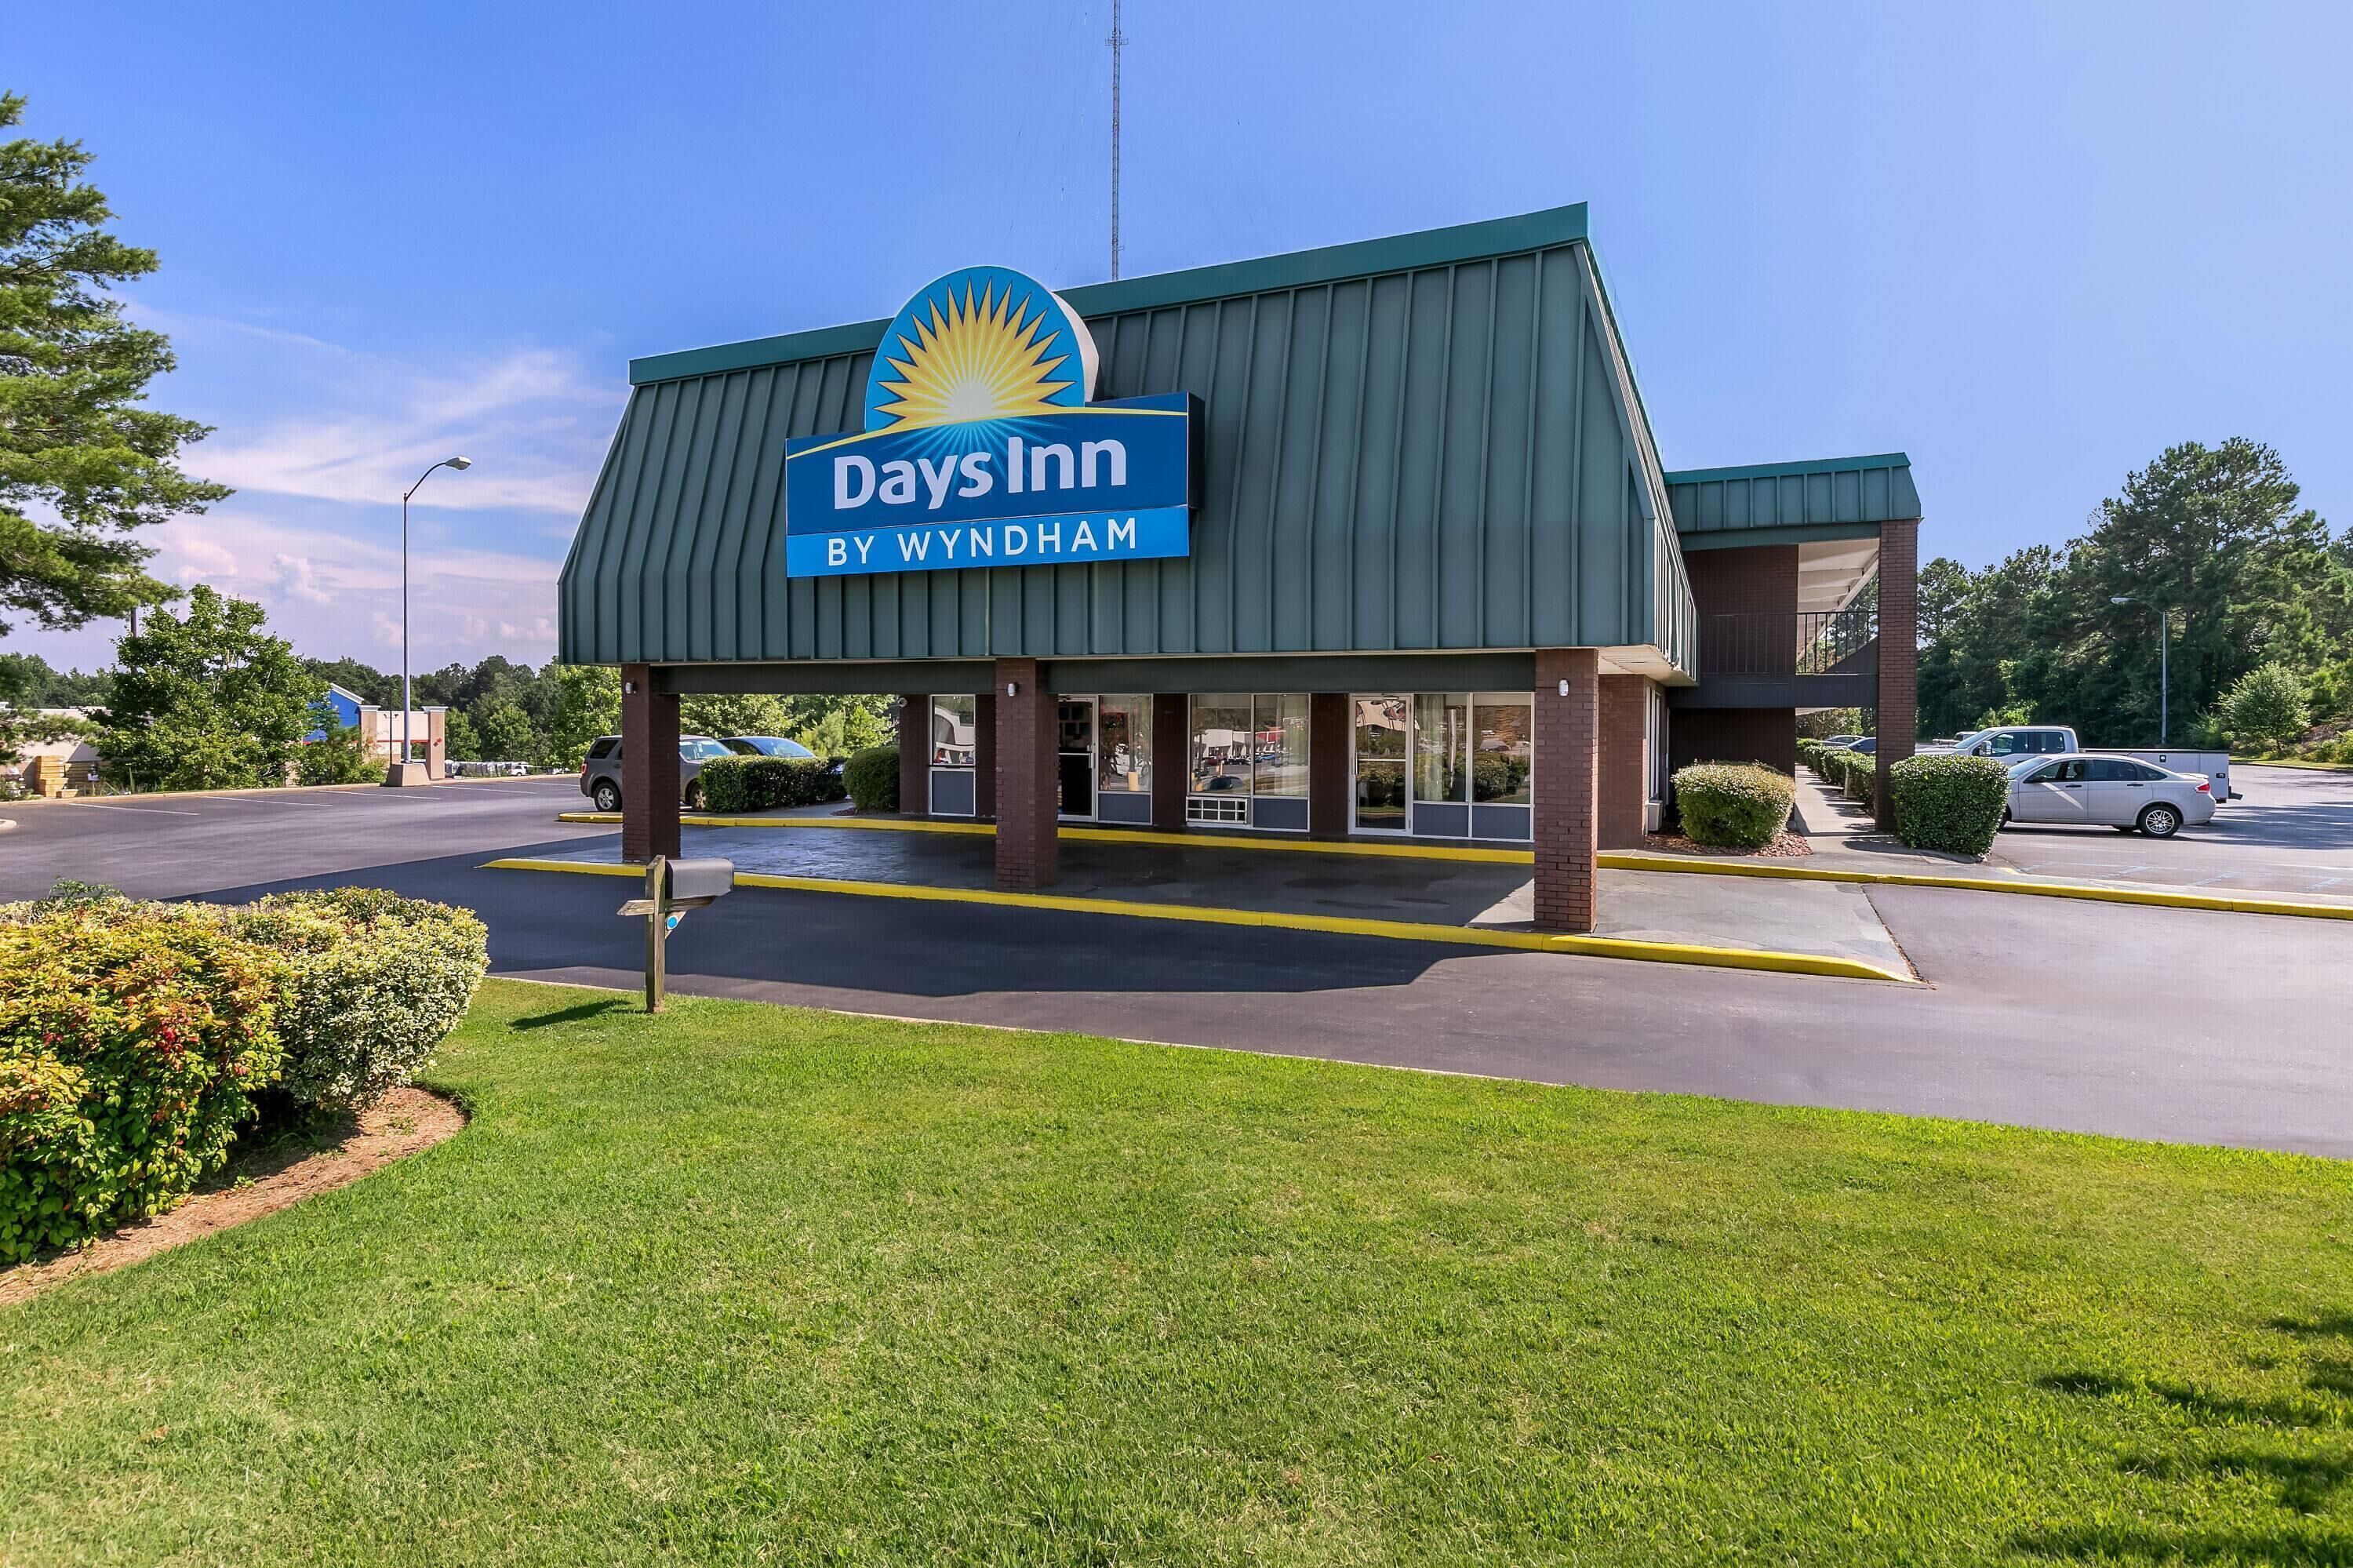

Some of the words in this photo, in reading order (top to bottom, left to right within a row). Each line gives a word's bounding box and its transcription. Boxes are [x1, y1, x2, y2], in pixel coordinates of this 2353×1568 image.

[835, 452, 993, 510] Days
[1009, 437, 1126, 493] Inn
[828, 536, 875, 566] BY
[897, 518, 1136, 562] WYNDHAM
